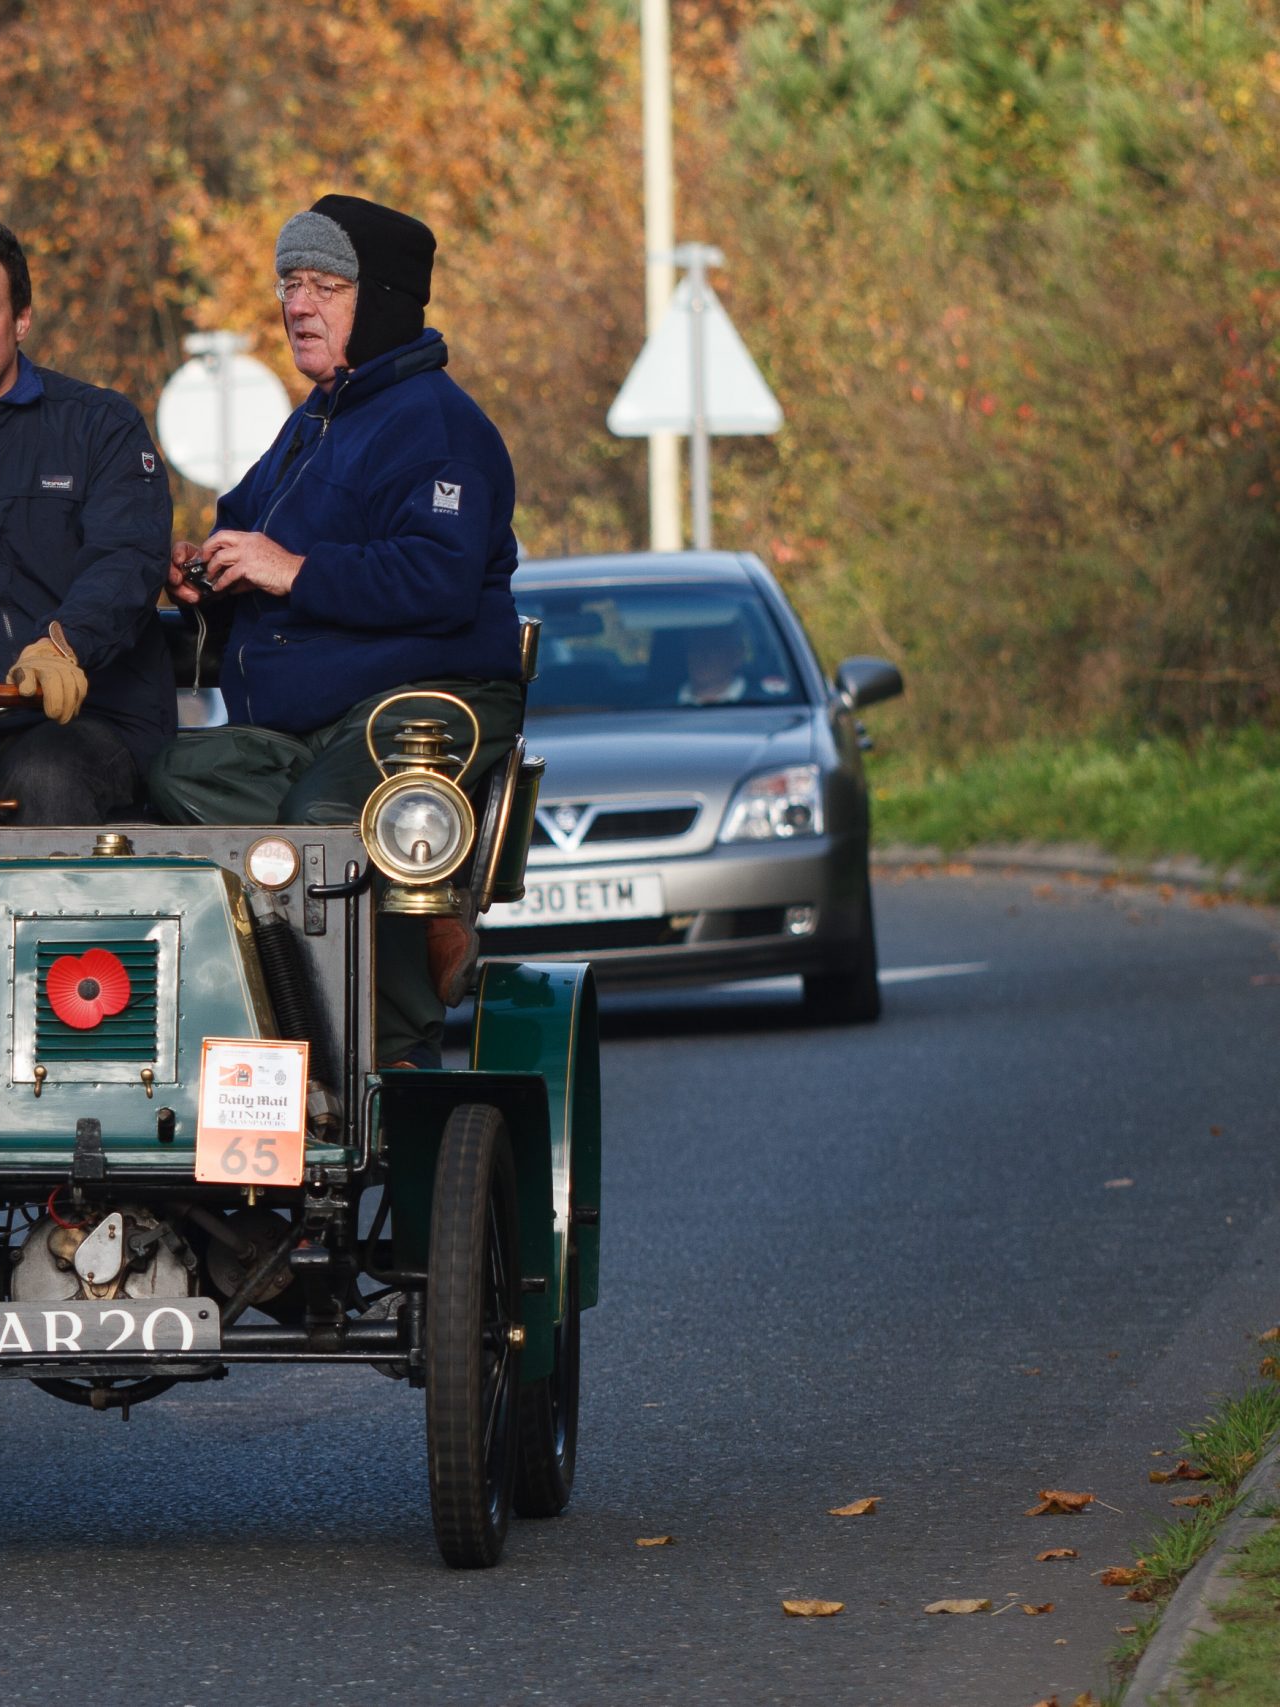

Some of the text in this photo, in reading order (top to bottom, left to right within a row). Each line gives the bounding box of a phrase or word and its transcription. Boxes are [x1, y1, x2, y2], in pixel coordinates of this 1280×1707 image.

[576, 879, 634, 910] ETM
[219, 1093, 288, 1108] Daily Mail
[228, 1110, 286, 1121] TINDLE
[221, 1136, 279, 1177] 65
